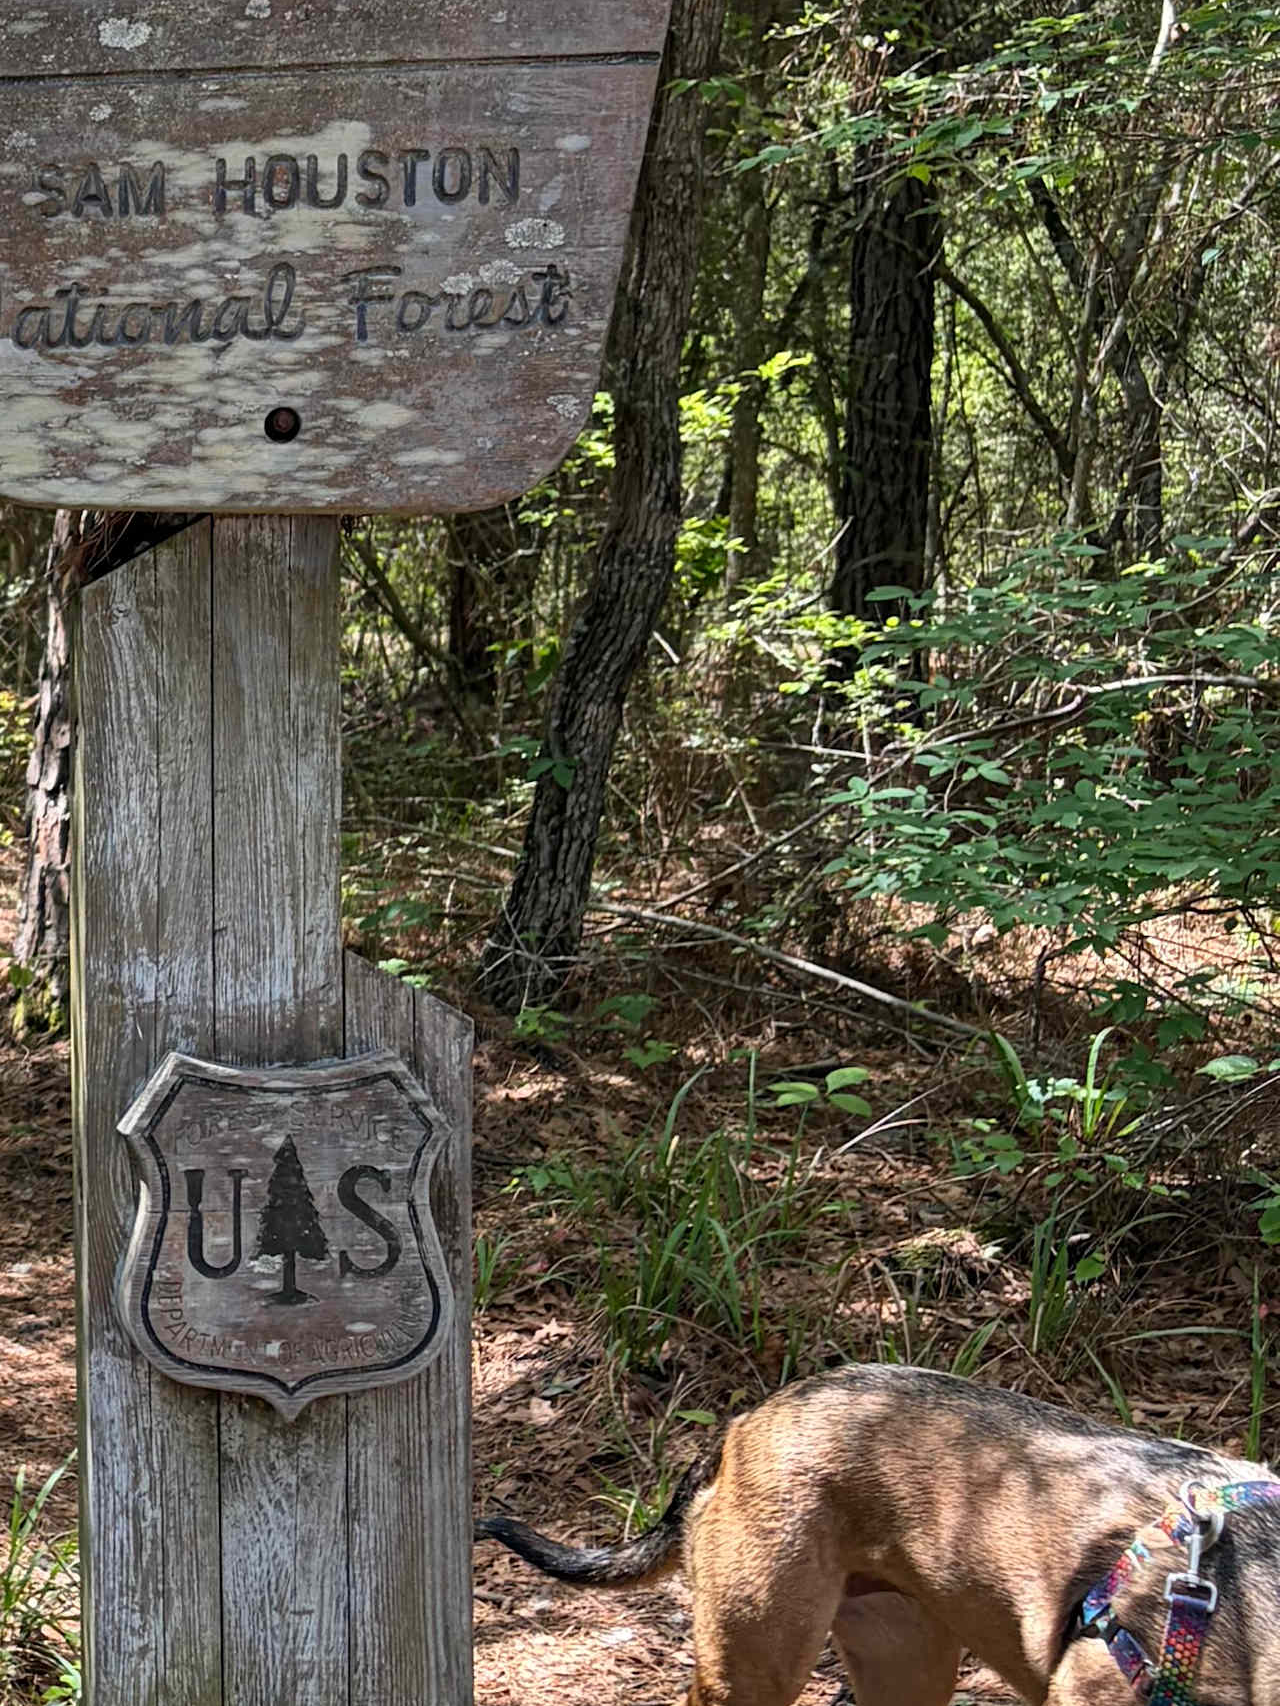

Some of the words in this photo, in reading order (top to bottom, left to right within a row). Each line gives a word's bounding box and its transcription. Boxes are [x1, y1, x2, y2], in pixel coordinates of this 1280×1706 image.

[32, 159, 166, 218] SAM
[213, 145, 522, 215] HOUSTON
[344, 263, 571, 344] Forest
[158, 1279, 281, 1365] DEPARTMEN
[312, 1280, 426, 1363] AGRICULTU
